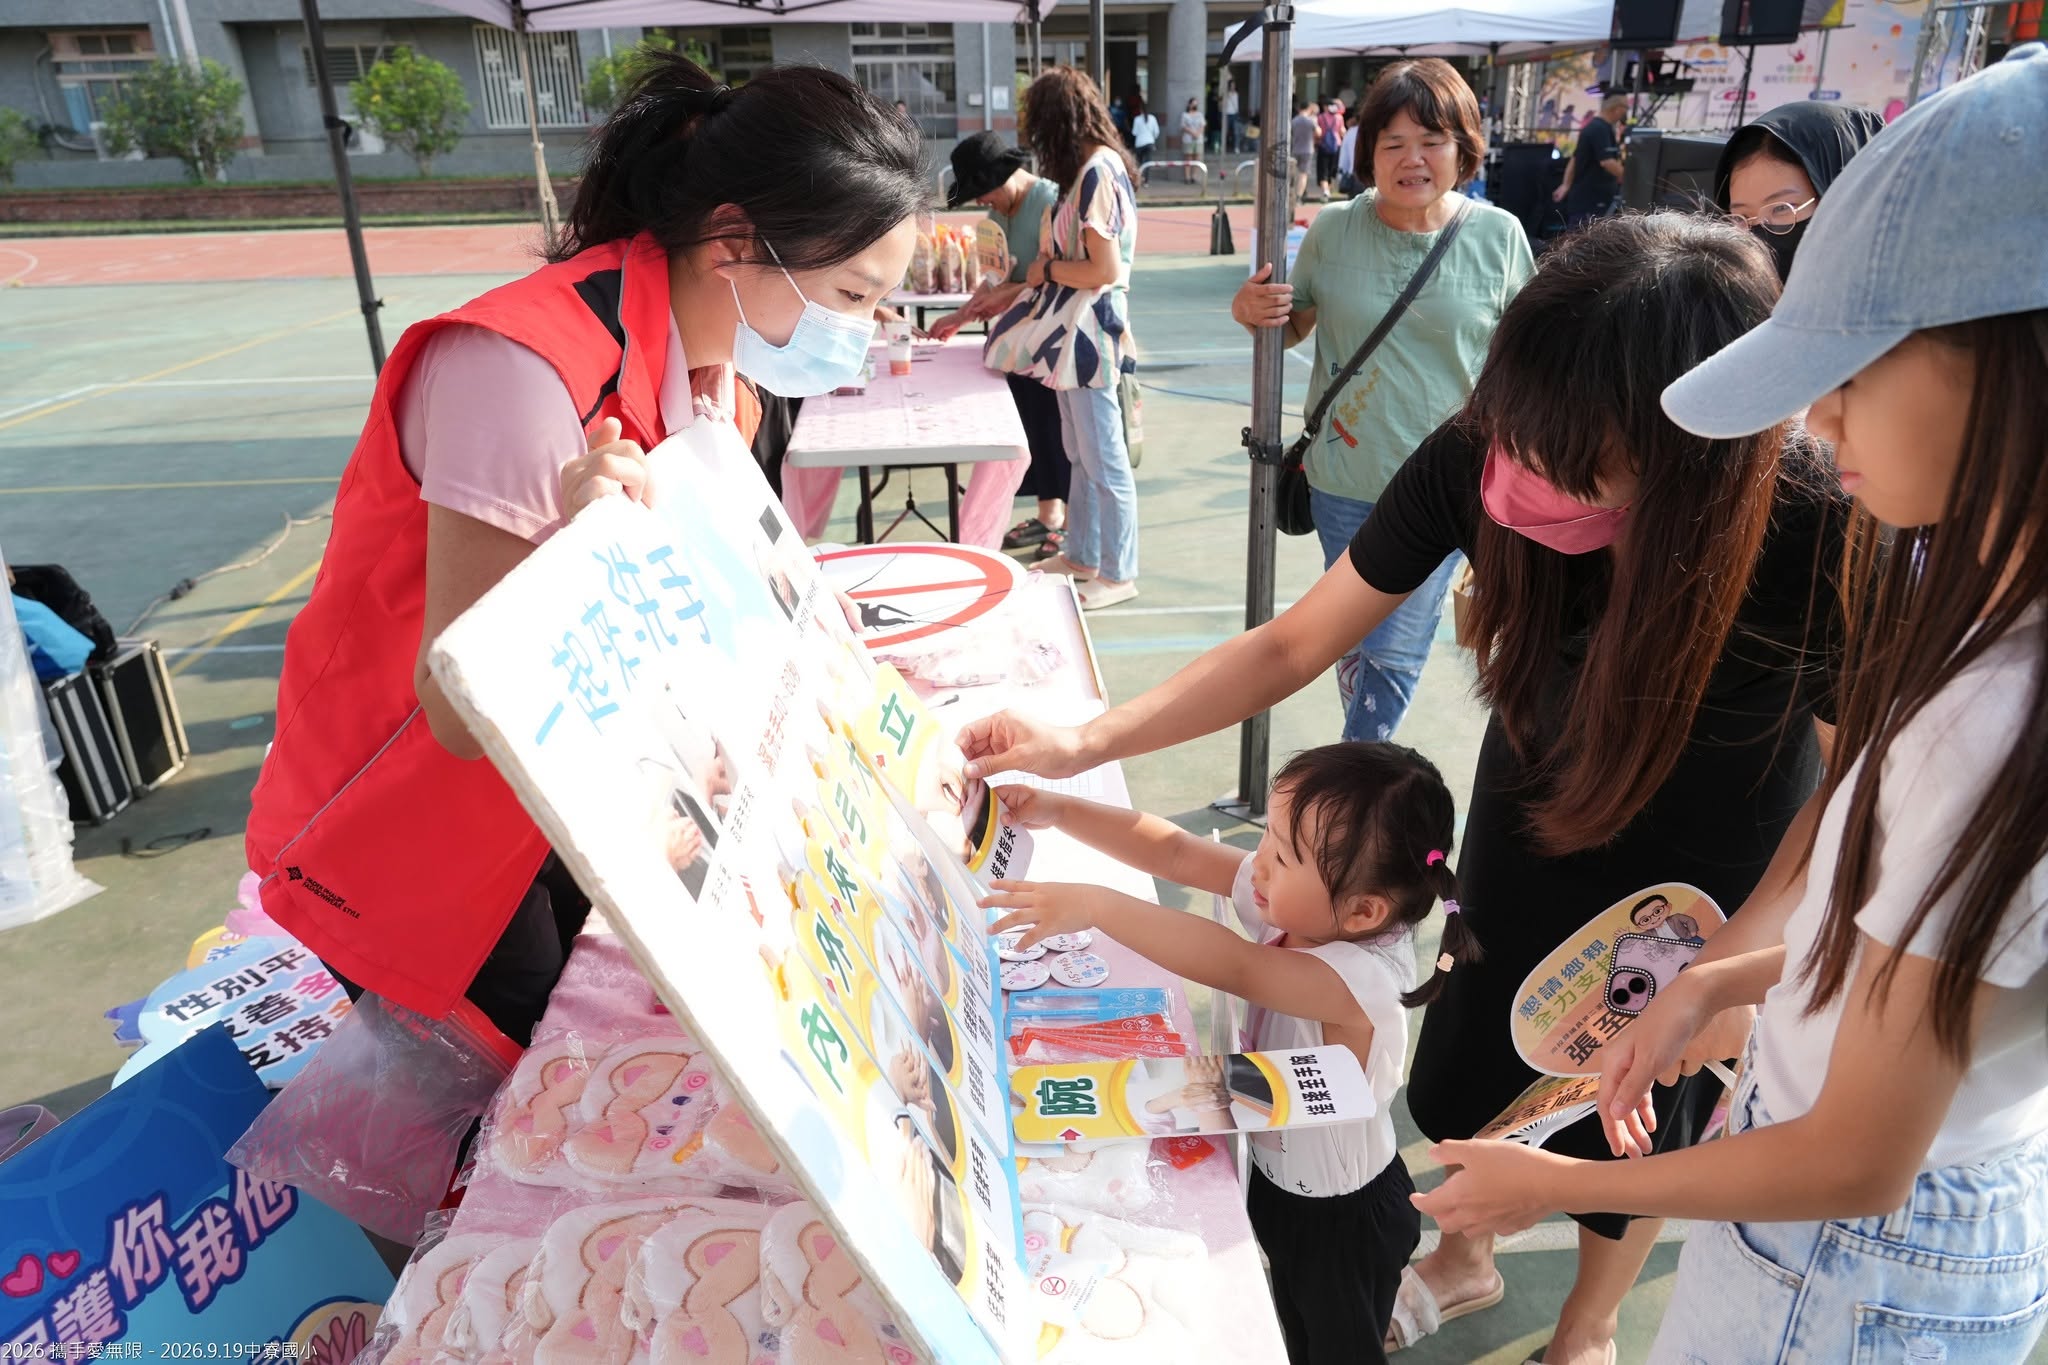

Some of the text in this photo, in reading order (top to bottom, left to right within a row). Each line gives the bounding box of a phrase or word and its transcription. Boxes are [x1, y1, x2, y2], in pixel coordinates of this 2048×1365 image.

[535, 542, 711, 746] 一起來洗手
[880, 692, 914, 756] 立
[835, 782, 866, 844] 弓
[1518, 939, 1608, 1021] 懇請鄉親
[1036, 1078, 1096, 1115] 腕
[1289, 1054, 1336, 1115] 搓揉至手腕
